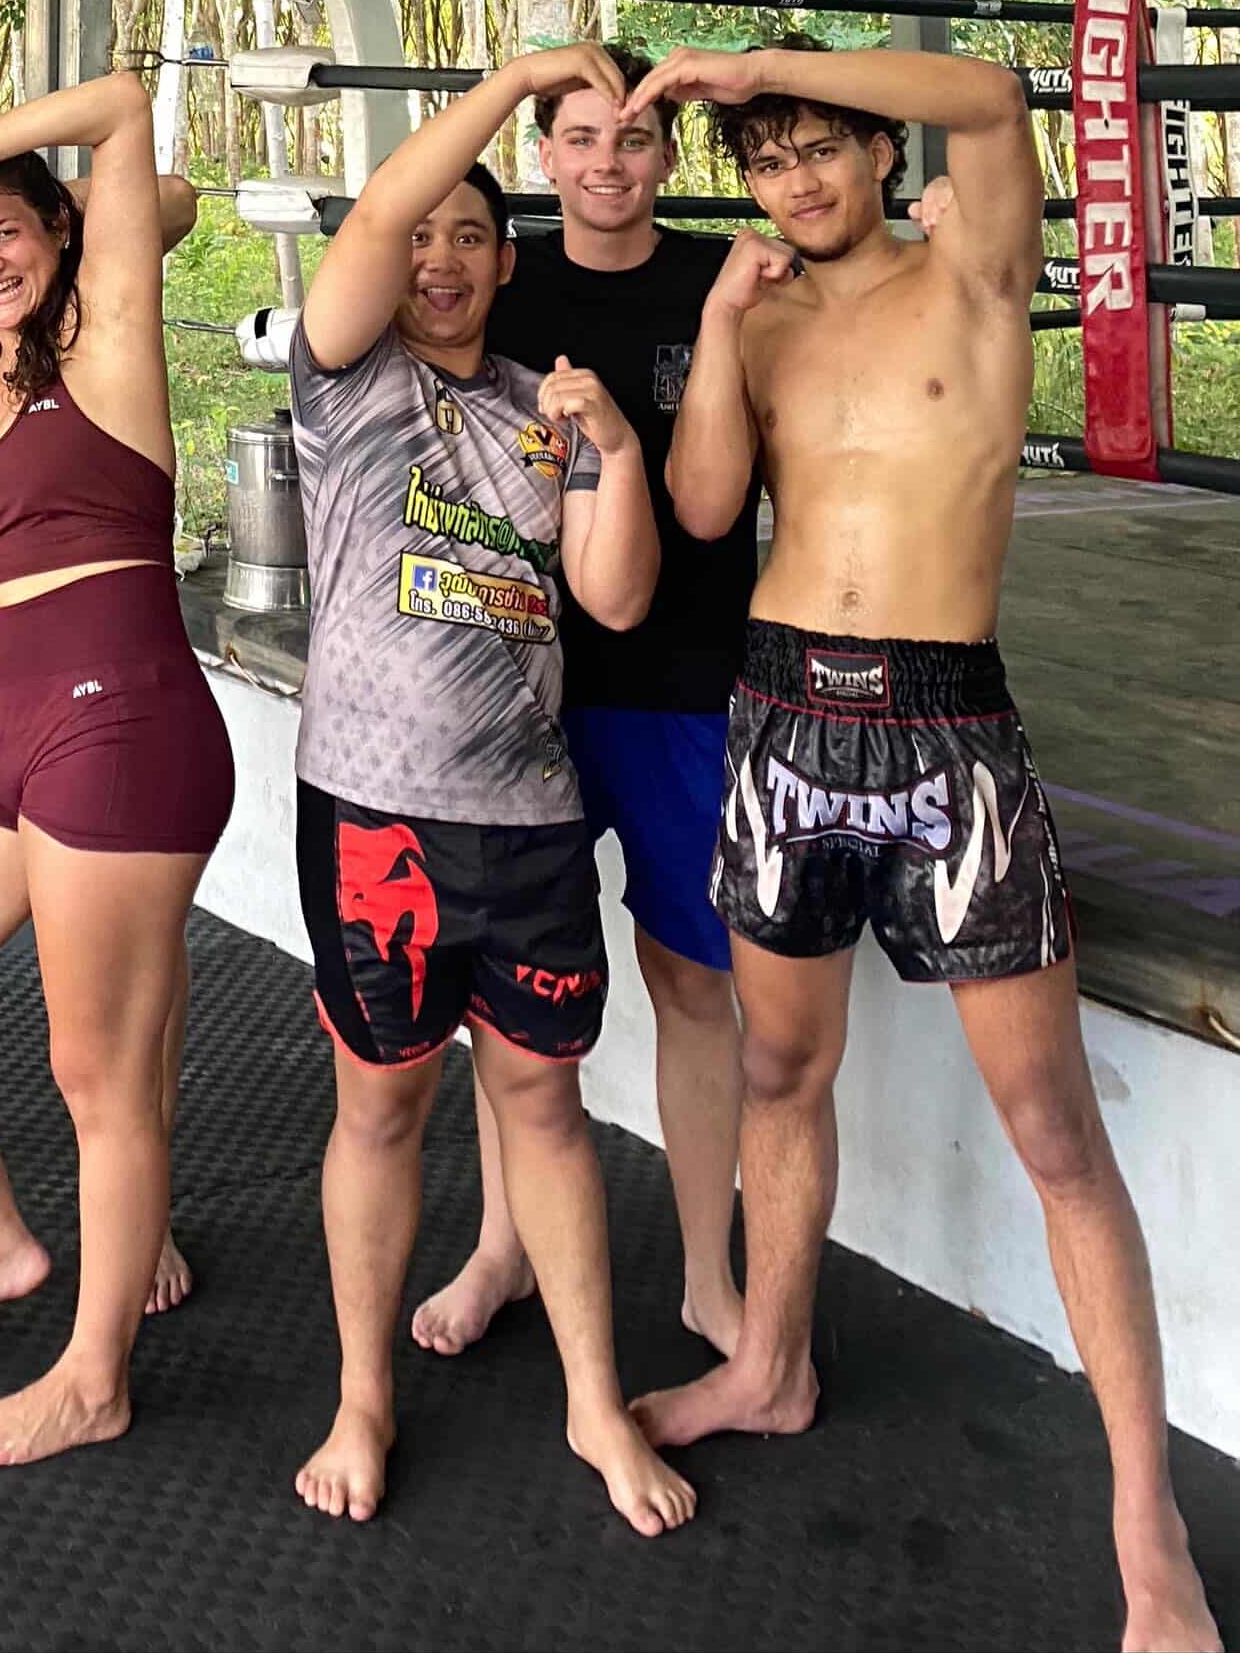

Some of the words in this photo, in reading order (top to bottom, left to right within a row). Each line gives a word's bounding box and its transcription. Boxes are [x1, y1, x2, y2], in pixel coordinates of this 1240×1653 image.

[72, 680, 103, 699] AYBL
[811, 657, 884, 695] TWINS
[767, 757, 952, 850] TWINS
